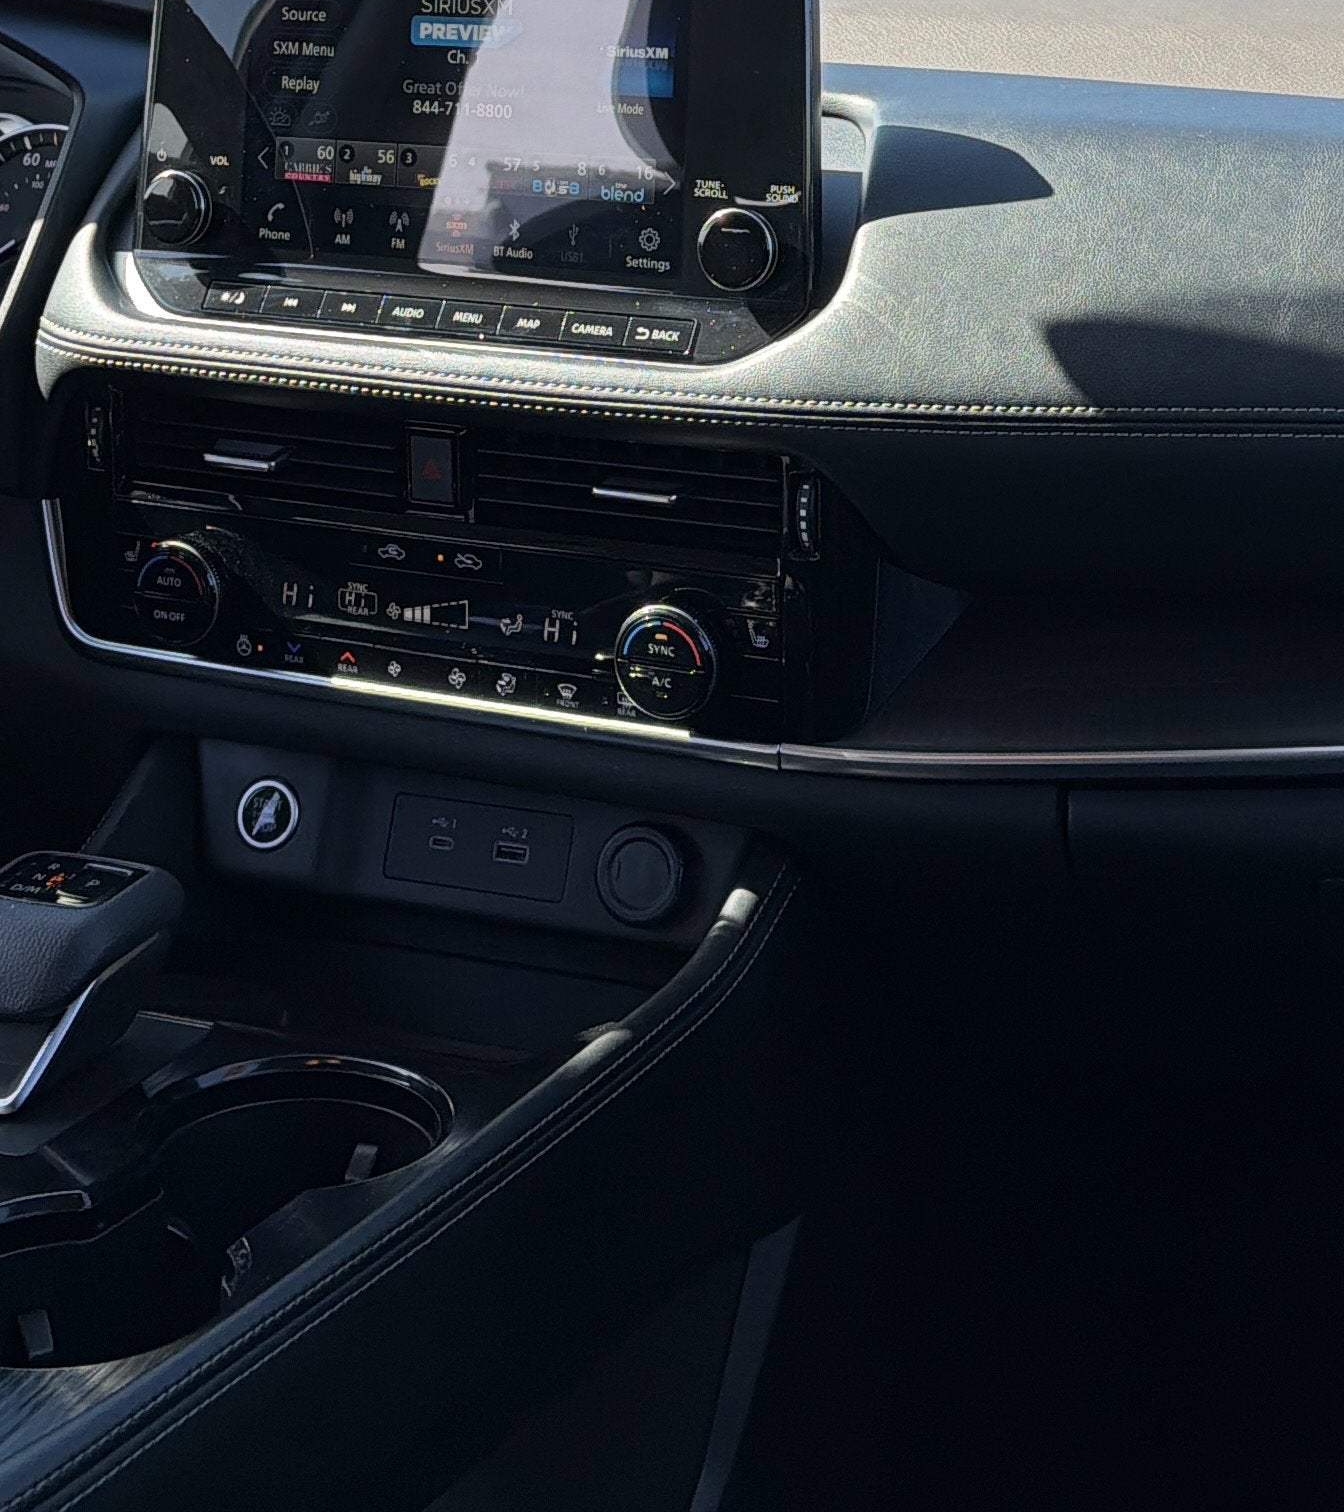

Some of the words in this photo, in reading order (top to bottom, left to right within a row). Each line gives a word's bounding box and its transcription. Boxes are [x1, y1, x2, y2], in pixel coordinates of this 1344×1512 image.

[281, 6, 327, 22] Source
[419, 22, 512, 41] PREVIEW
[273, 41, 299, 56] SXM
[302, 43, 335, 57] Menu
[607, 45, 669, 59] SiriusXM
[447, 51, 468, 64] Ch.
[281, 76, 320, 94] Replay
[403, 80, 441, 95] Great
[413, 100, 512, 119] 844-711-8800
[617, 103, 644, 116] Mode
[317, 145, 334, 161] 60
[343, 149, 351, 160] 2
[377, 149, 395, 164] 56
[405, 153, 413, 163] 3
[22, 153, 40, 167] 60
[209, 155, 230, 166] VOL
[504, 156, 521, 172] 57
[533, 161, 540, 171] 5
[577, 162, 587, 176] 8
[598, 165, 606, 176] 6
[637, 166, 654, 180] 16
[349, 169, 382, 185] highway
[601, 185, 644, 202] blend
[694, 188, 728, 199] SCROLL
[770, 185, 795, 194] PUSH
[766, 193, 799, 203] SOUND
[259, 228, 291, 240] Phone
[335, 234, 350, 245] AM
[391, 238, 405, 249] FM
[436, 241, 474, 255] SiriusXM
[494, 245, 505, 257] BT
[507, 246, 533, 259] Audio
[626, 256, 670, 272] Settings
[391, 307, 424, 319] AUDIO
[452, 311, 483, 324] MENU
[517, 318, 541, 329] MAP
[571, 323, 613, 337] CAMERA
[651, 330, 680, 342] BACK
[156, 575, 181, 588] AUTO
[348, 582, 368, 592] SYNC
[347, 606, 369, 616] REAR
[551, 609, 574, 621] SYNC
[648, 644, 675, 657] SYNC
[337, 663, 358, 674] REAR
[651, 676, 672, 689] A/C
